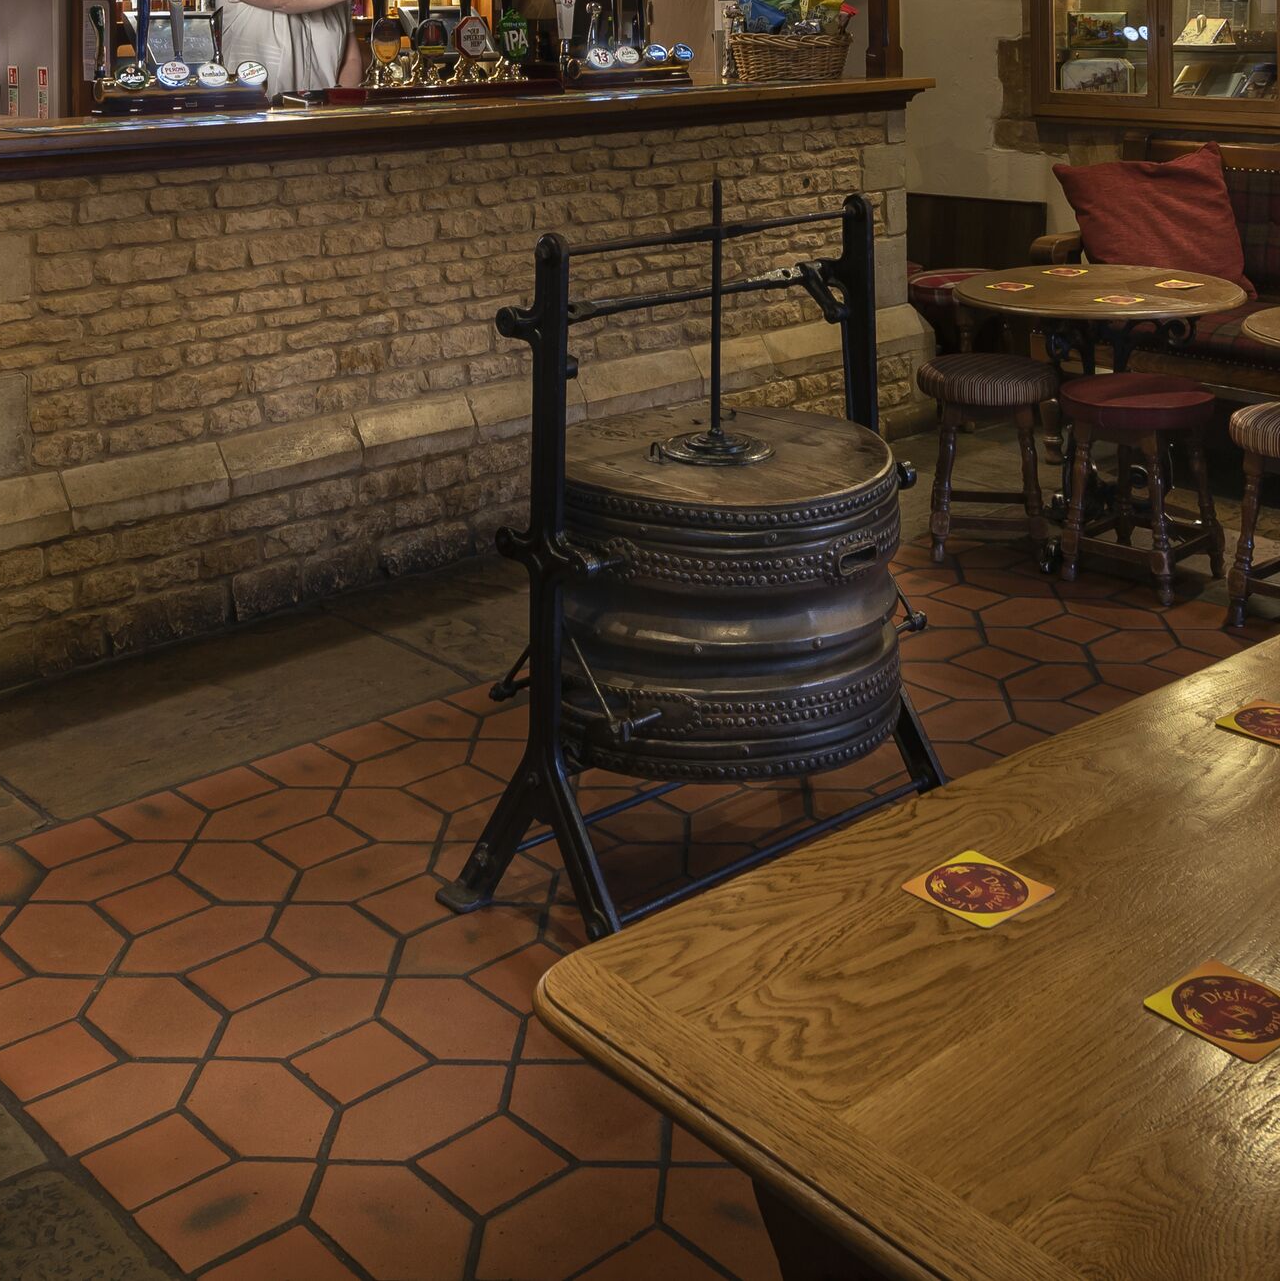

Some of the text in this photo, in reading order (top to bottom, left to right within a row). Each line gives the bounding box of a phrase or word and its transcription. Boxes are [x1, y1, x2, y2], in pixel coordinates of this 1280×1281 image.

[504, 28, 528, 51] IPA
[981, 876, 1011, 910] Digfield
[1200, 988, 1280, 1008] Digfield
